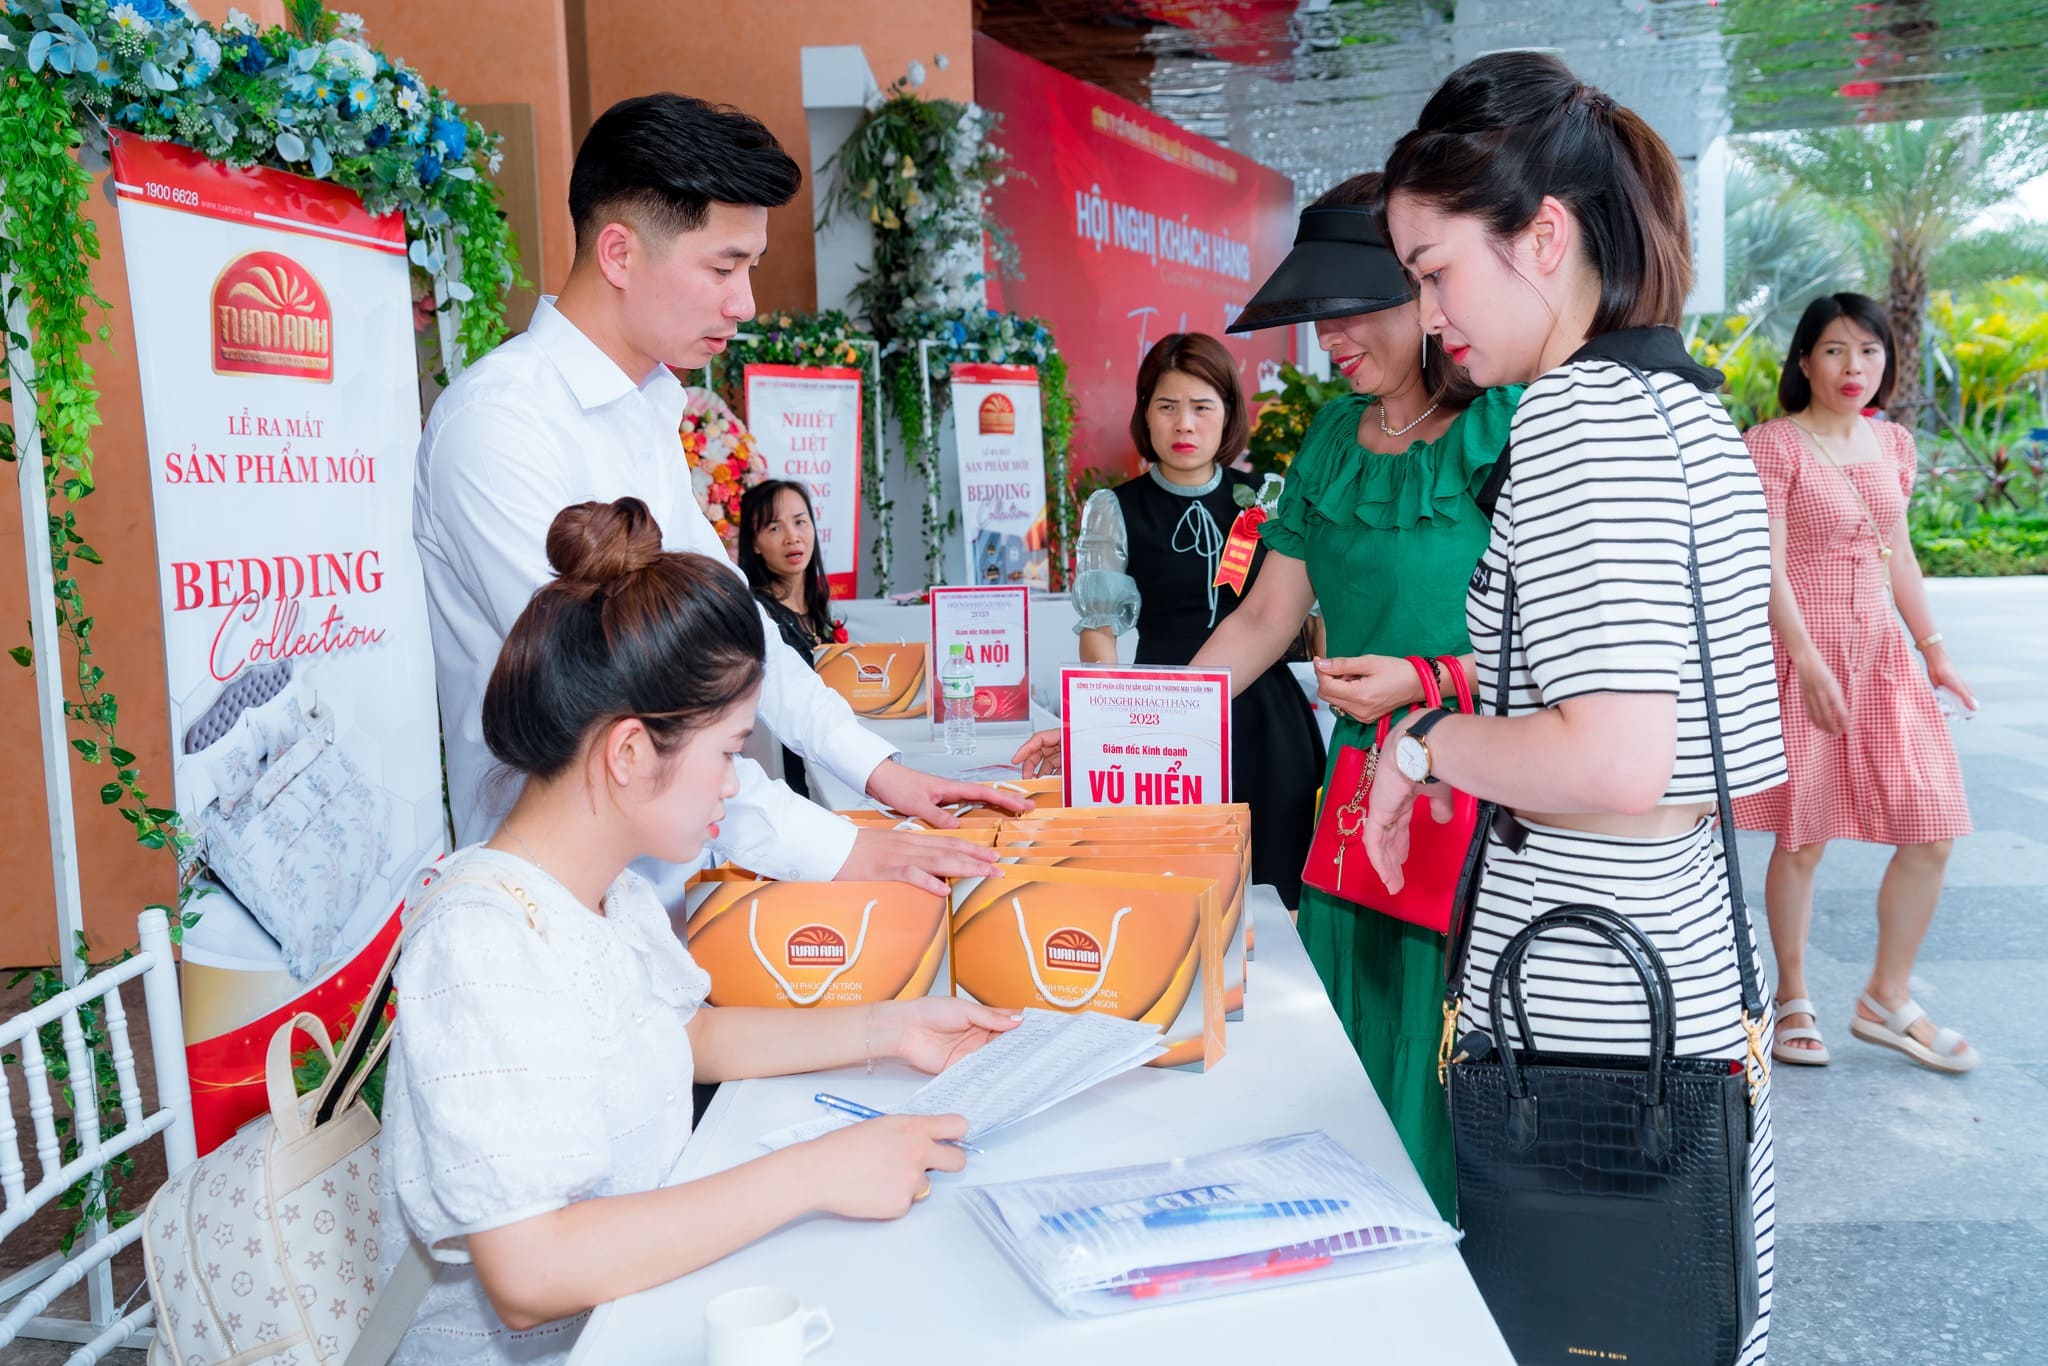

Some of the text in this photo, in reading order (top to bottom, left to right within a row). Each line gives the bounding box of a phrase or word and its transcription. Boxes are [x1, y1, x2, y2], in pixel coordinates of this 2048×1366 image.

[145, 181, 170, 200] 1900
[172, 187, 199, 206] 6628
[1075, 183, 1251, 282] HỘI NGHỊ KHÁCH HÀNG
[282, 314, 329, 355] ANH
[227, 407, 252, 436] LỄ
[257, 417, 282, 437] RA
[783, 409, 836, 430] NHIỆT
[165, 441, 377, 485] SẢN PHẨM MỚI
[784, 457, 831, 476] CHÀO
[968, 482, 1030, 502] BEDDING
[171, 549, 384, 611] BEDDING
[209, 589, 386, 682] Collection
[980, 640, 1009, 668] NỘI
[1089, 694, 1200, 708] HỘI NGHỊ KHÁCH HÀNG
[1129, 713, 1160, 725] 2023
[1103, 743, 1188, 757] Giám đốc Kinh doanh
[1088, 760, 1203, 805] VŨ HIỂN
[820, 944, 843, 957] ANH
[1076, 949, 1099, 963] ANH
[840, 981, 862, 991] TRÒN
[838, 992, 862, 1001] NGON
[1094, 1000, 1118, 1009] NGON
